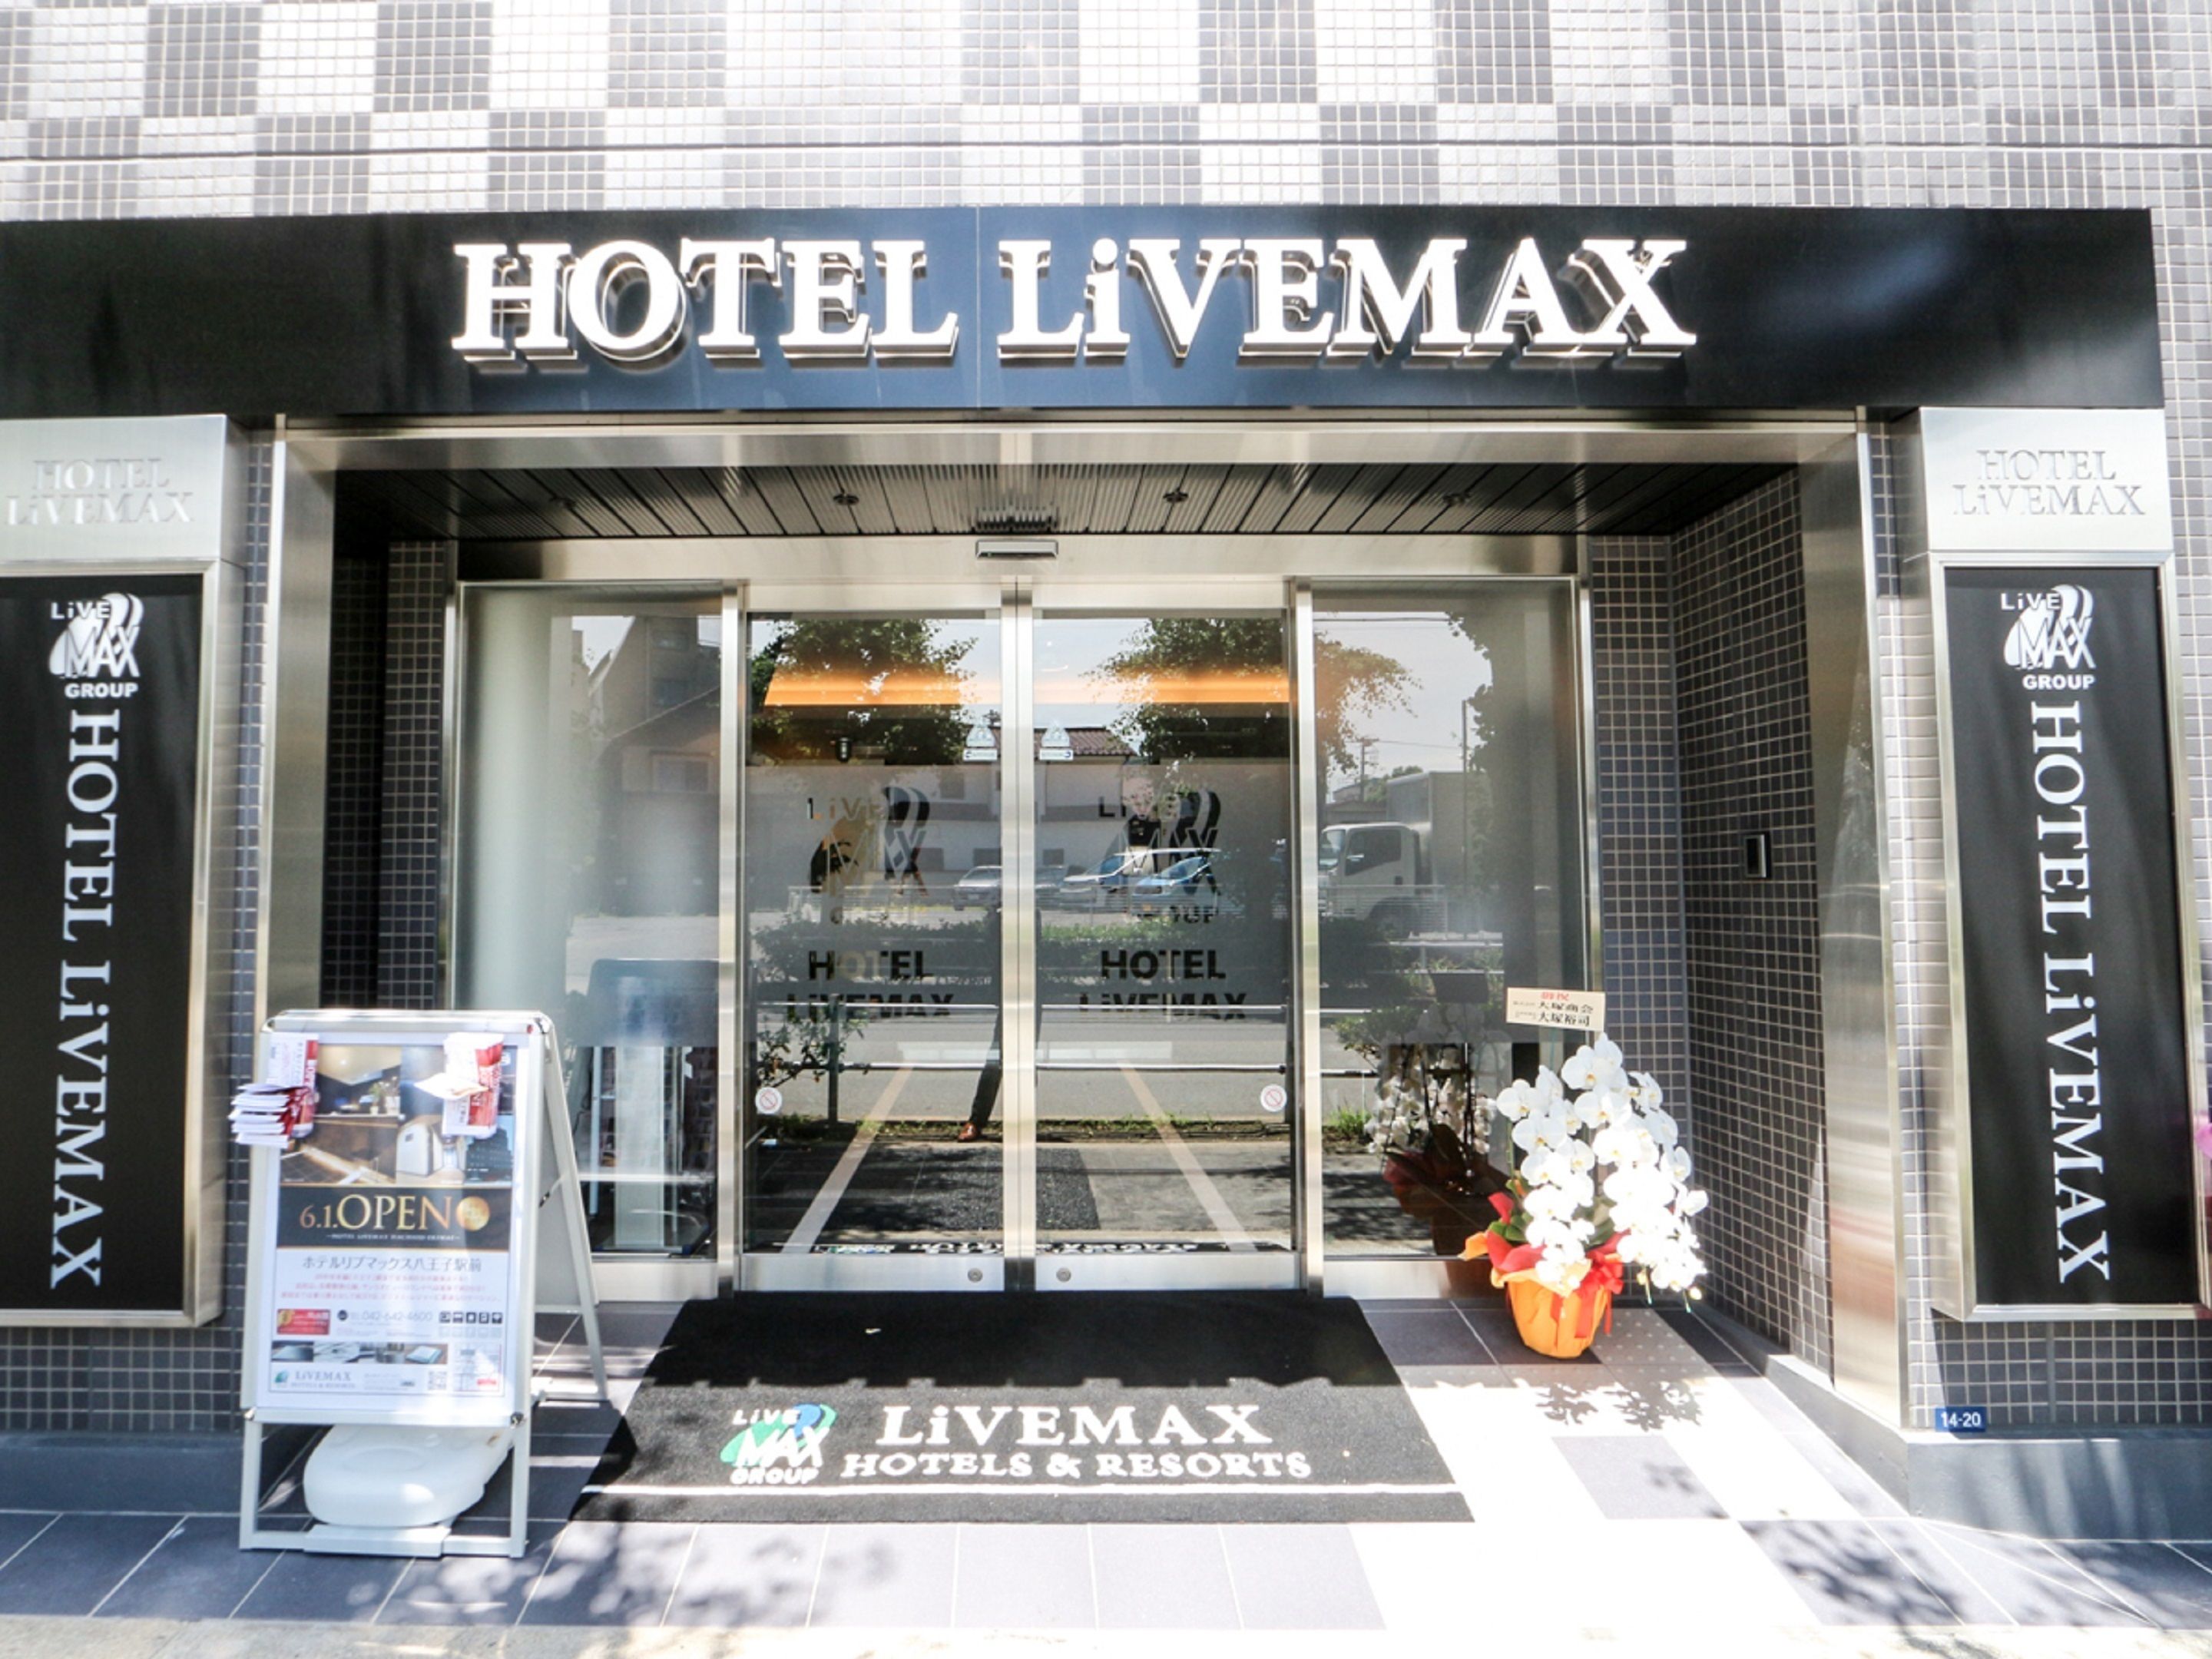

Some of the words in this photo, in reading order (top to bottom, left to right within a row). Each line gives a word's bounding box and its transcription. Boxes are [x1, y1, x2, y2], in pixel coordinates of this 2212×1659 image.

[452, 239, 960, 358] HOTEL
[997, 237, 1698, 358] LiVEMAX
[33, 459, 171, 490] HOTEL
[1976, 449, 2117, 481] HOTEL
[1952, 484, 2146, 516] LiVEMAX
[51, 601, 112, 620] LiVE
[2001, 593, 2062, 611] LiVE
[63, 625, 141, 678] MAX
[2018, 616, 2097, 670] MAX
[65, 683, 139, 699] GROUP
[2022, 674, 2097, 691] GROUP
[63, 709, 121, 942] HOTEL
[2030, 700, 2093, 935] HOTEL
[809, 949, 932, 981] HOTEL
[1101, 949, 1227, 980] HOTEL
[51, 960, 111, 1289] LiVEMAX
[2044, 952, 2111, 1285] LiVEMAX
[876, 1405, 1272, 1445] LiVEMAX
[1941, 1412, 1982, 1428] 14-20
[733, 1426, 830, 1468] MAX
[730, 1467, 820, 1485] GROUP
[840, 1452, 1033, 1479] HOTELS
[1045, 1452, 1081, 1479] &
[1096, 1451, 1312, 1479] RESORTS
